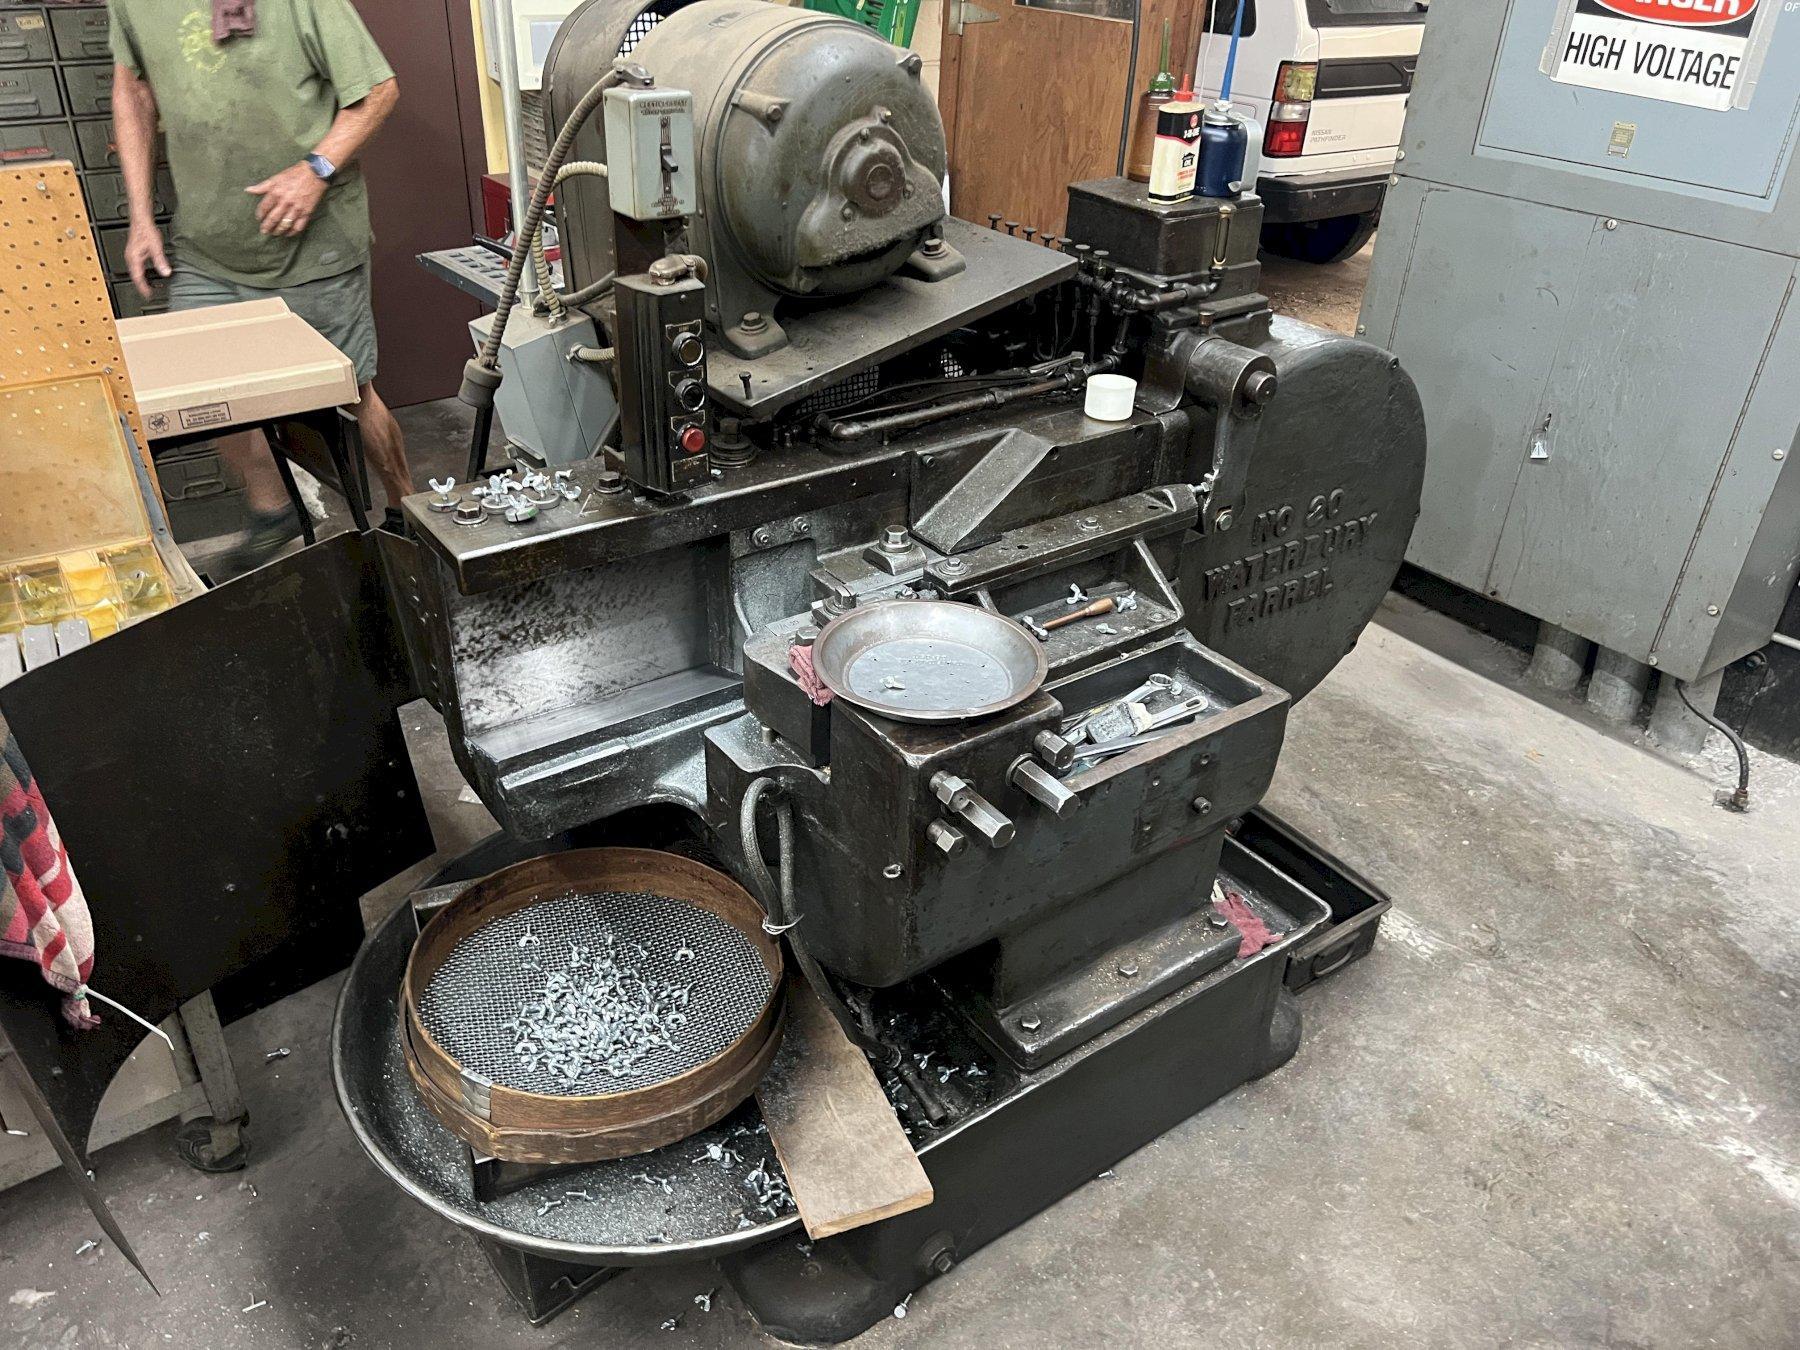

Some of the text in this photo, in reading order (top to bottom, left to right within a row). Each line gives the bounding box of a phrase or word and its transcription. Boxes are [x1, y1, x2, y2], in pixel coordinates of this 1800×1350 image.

[1563, 31, 1741, 90] HIGH VOLTAGE
[1204, 511, 1378, 601] WATERBURY
